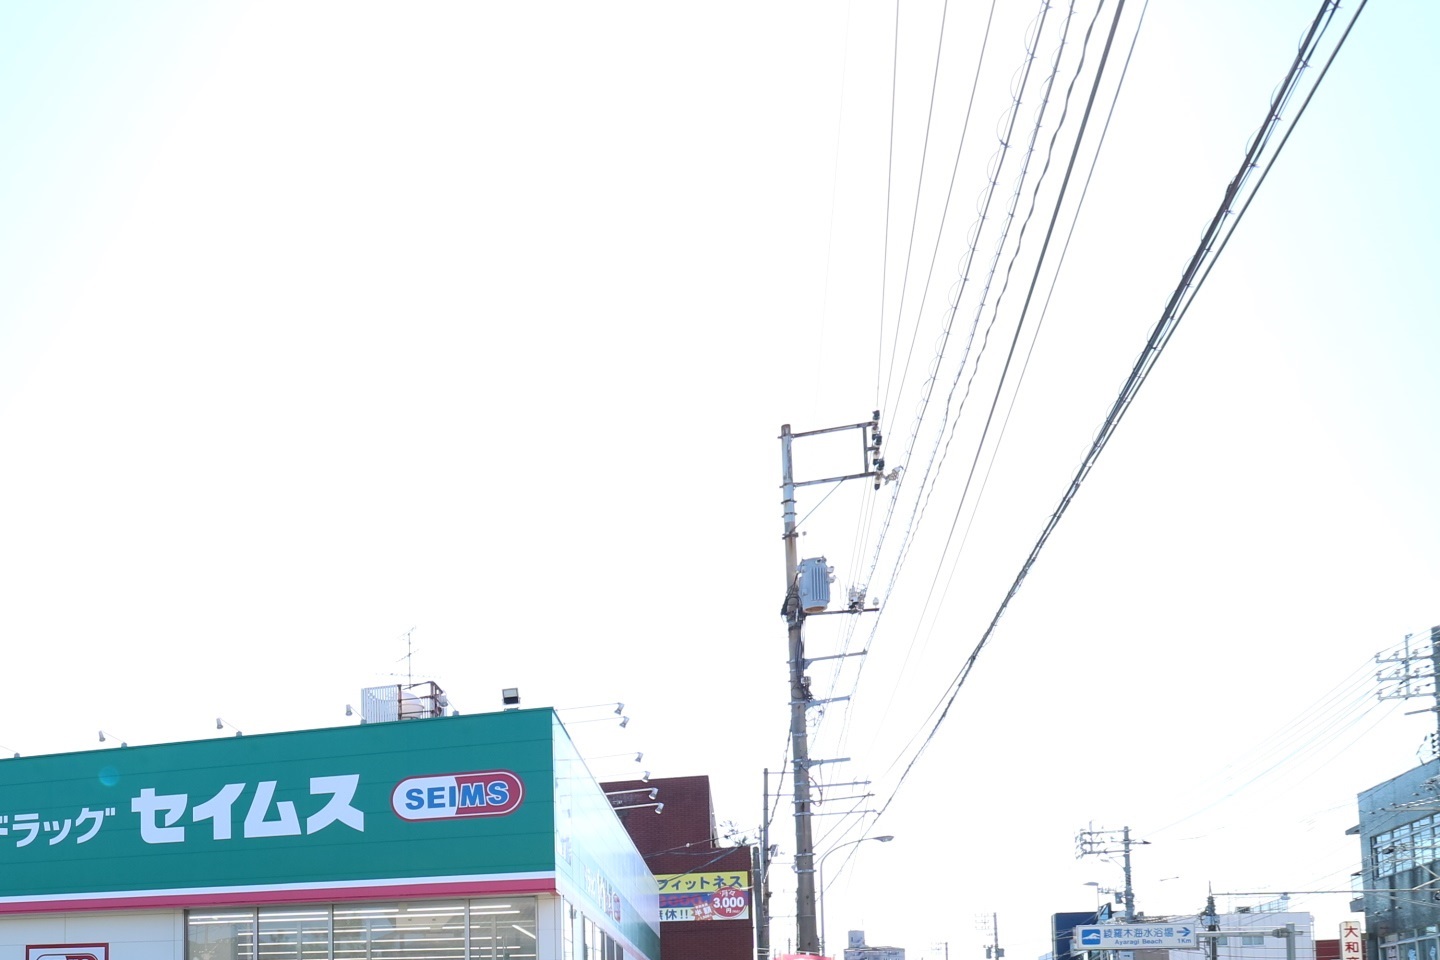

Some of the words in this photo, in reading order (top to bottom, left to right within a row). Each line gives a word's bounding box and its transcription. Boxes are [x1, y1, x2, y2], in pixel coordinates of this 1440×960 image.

[404, 780, 510, 811] SEIMS
[131, 774, 365, 844] セイムス
[713, 896, 744, 909] 3,000
[1103, 927, 1174, 938] 綾羅木海水浴場
[1114, 938, 1140, 946] Ayaragi
